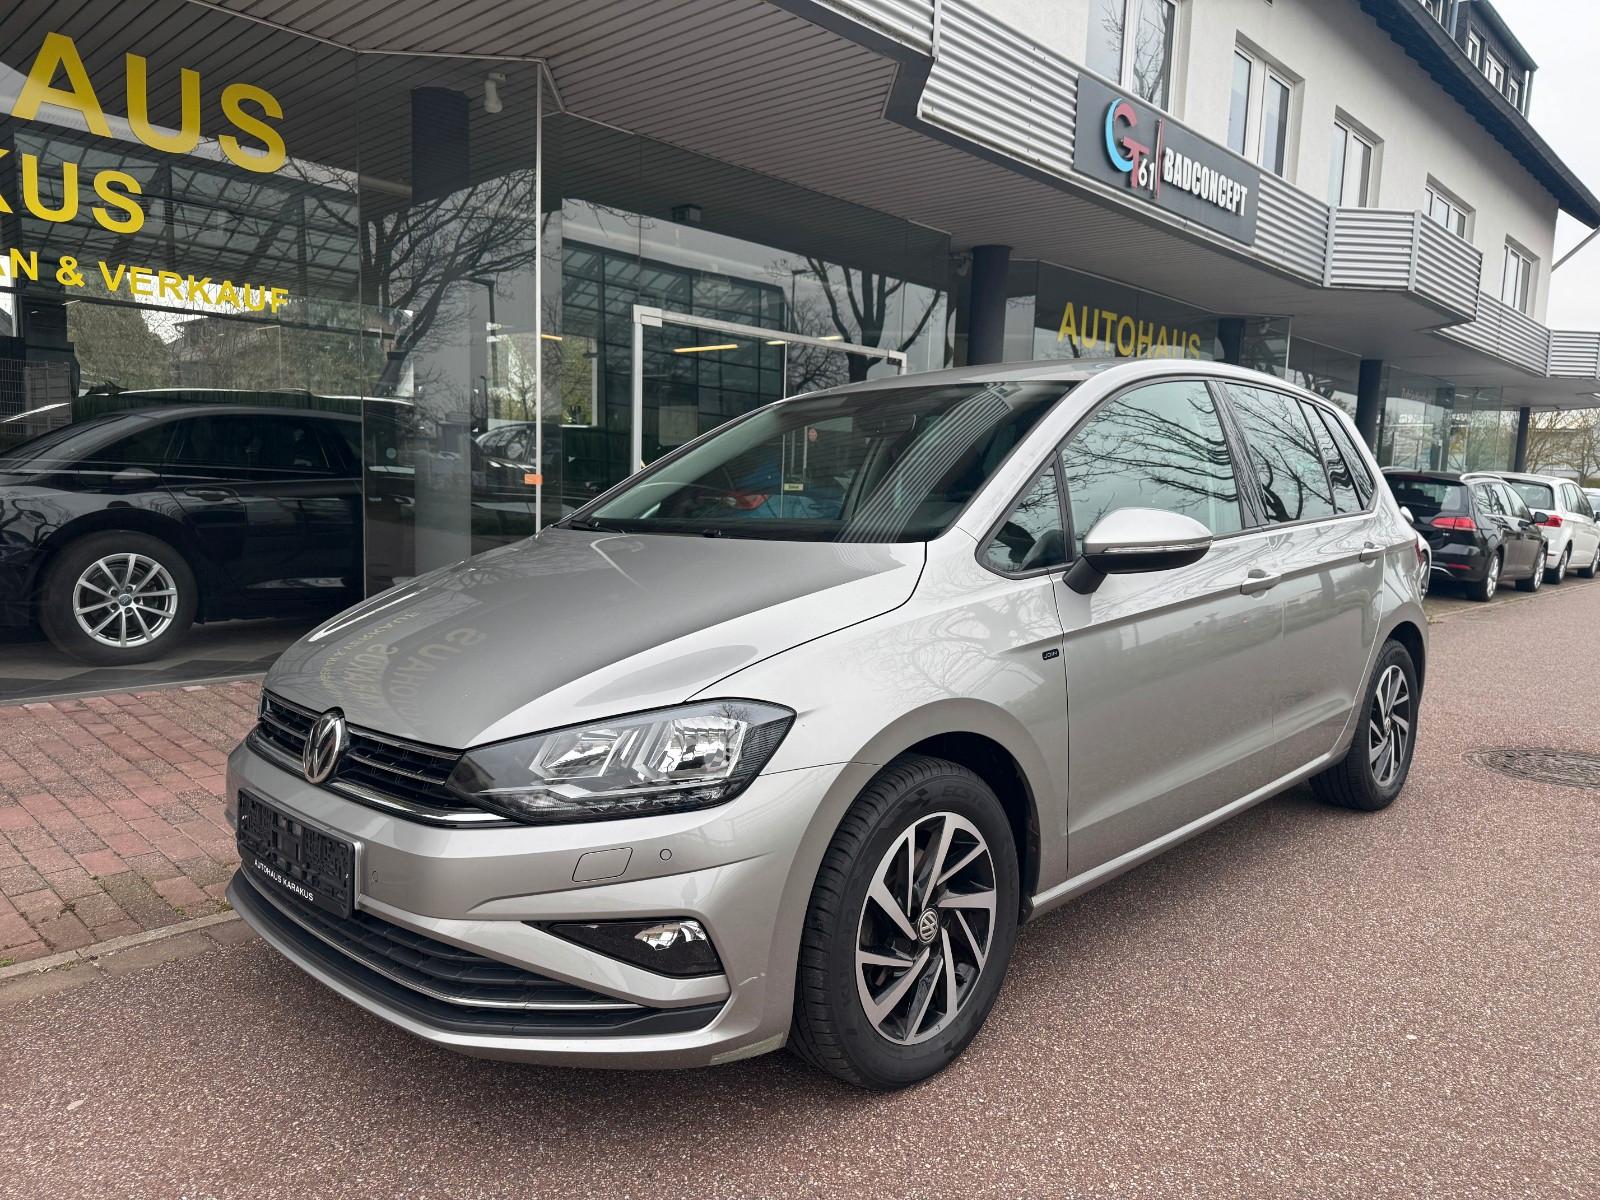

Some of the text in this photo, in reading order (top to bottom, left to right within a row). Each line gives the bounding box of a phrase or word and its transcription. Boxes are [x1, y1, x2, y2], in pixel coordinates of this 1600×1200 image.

[10, 31, 287, 173] AUS
[1164, 147, 1248, 217] BADCONCEPT
[55, 255, 85, 288] &
[98, 260, 289, 314] VERKAUF
[1056, 301, 1201, 359] AUTOHAUS
[254, 858, 314, 902] AUTOHAUS KARAKUS
